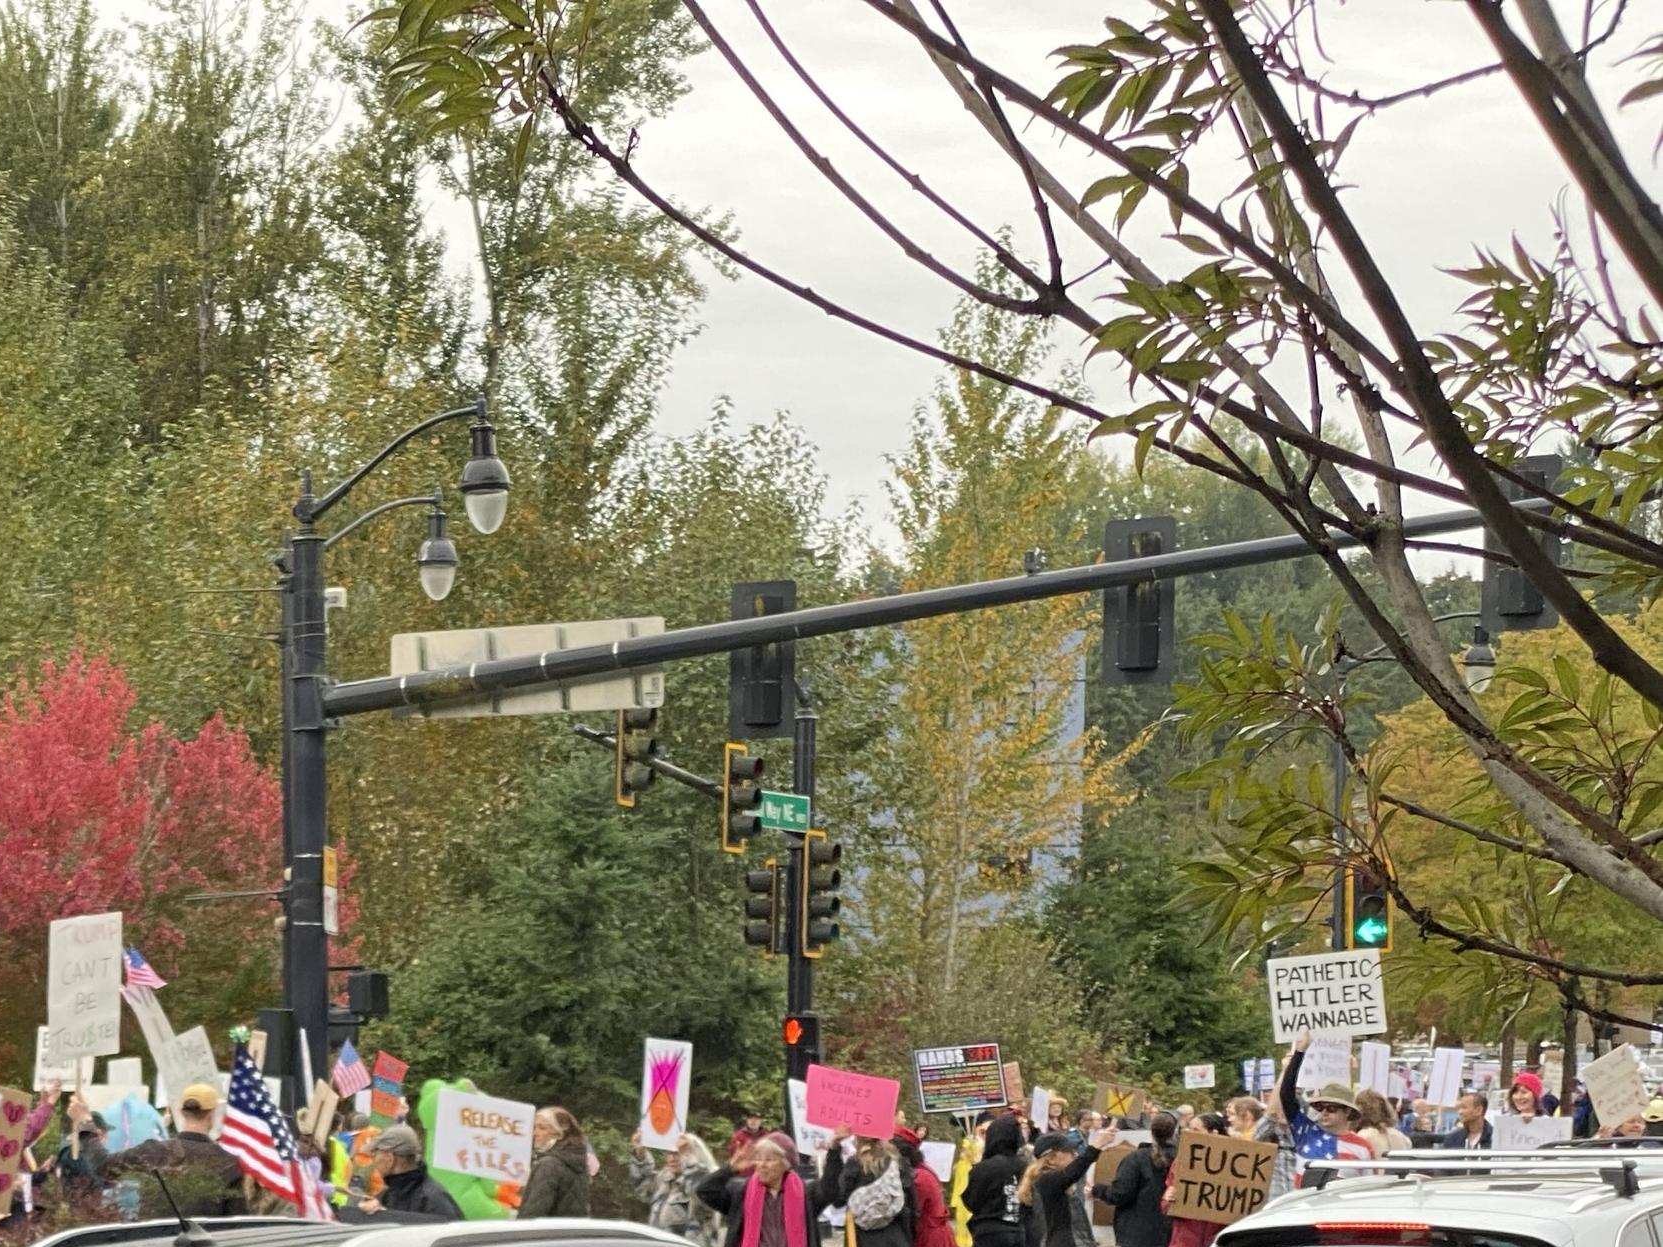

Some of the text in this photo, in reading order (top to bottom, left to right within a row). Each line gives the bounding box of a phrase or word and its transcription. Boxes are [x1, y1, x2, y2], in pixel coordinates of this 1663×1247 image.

[1275, 959, 1372, 985] PATHETIC
[75, 991, 98, 1014] BE
[1277, 983, 1374, 1010] HITLER
[1279, 1005, 1379, 1033] WANNABE
[918, 1049, 965, 1067] HANDS
[820, 1080, 872, 1099] VACCINES
[460, 1107, 524, 1136] RELEASE
[820, 1105, 872, 1126] ADULTS
[456, 1148, 526, 1178] FILES
[1189, 1143, 1272, 1182] FUCK
[1179, 1179, 1266, 1214] TRUMP
